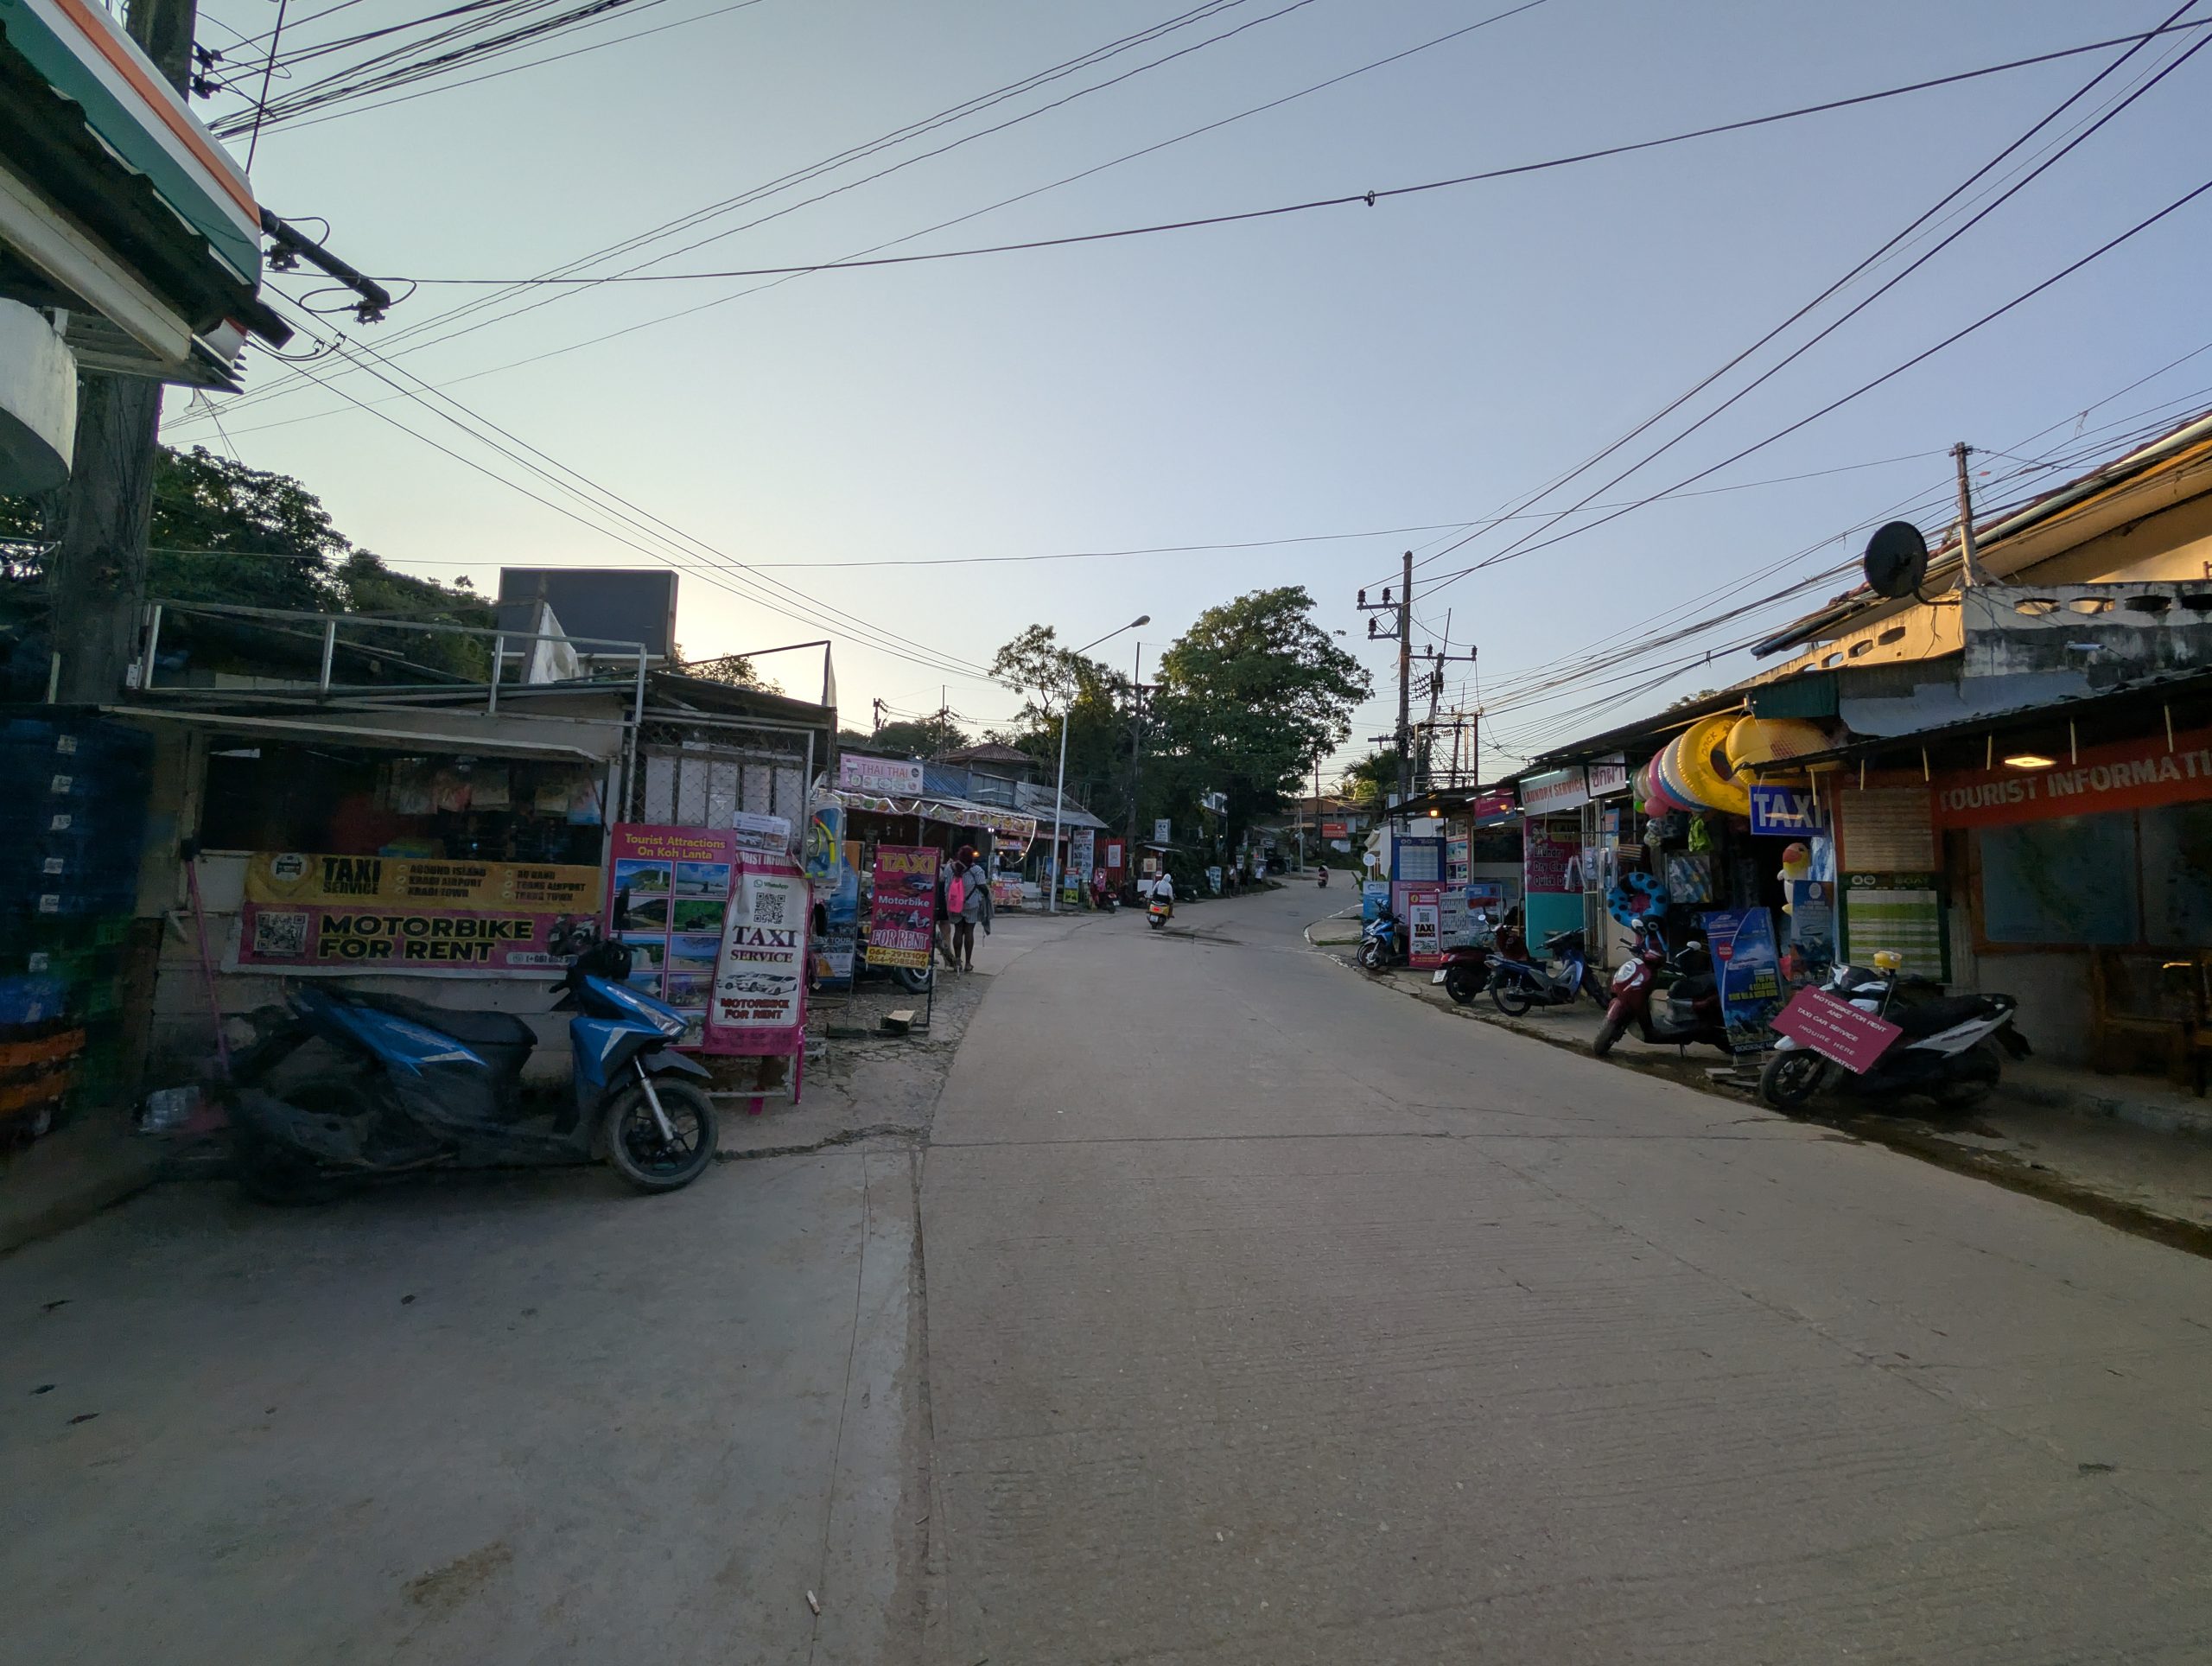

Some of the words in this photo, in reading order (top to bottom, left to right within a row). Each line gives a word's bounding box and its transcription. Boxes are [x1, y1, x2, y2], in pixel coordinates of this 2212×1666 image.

[861, 764, 883, 775] THAI
[887, 766, 908, 778] THAI
[1939, 777, 2037, 812] TOURIST
[2046, 748, 2212, 798] INFORMATI
[1522, 784, 1553, 804] LAUNDRY
[1554, 779, 1585, 798] SERVICE
[1753, 793, 1822, 829] TAXI
[626, 834, 664, 844] Tourist
[667, 836, 725, 849] Attractions
[638, 846, 654, 856] On
[658, 847, 679, 857] Koh
[683, 849, 712, 859] Lanta
[322, 858, 381, 882] TAXI
[879, 852, 936, 874] TAXI
[1534, 862, 1548, 873] Dry
[322, 881, 378, 894] SERVICE
[442, 878, 482, 887] AIRPORT
[1534, 874, 1555, 886] Quick
[879, 895, 930, 906] Motorbike
[322, 914, 532, 939] MOTORBIKE
[1414, 924, 1435, 932] TAXI
[733, 925, 797, 948] TAXI
[871, 929, 895, 948] FOR
[898, 930, 929, 950] RENT
[319, 938, 392, 959] FOR
[404, 940, 494, 961] RENT
[730, 950, 792, 963] SERVICE
[721, 998, 789, 1009] MOTORBIKE
[724, 1009, 750, 1019] FOR
[753, 1009, 783, 1020] RENT
[1813, 993, 1853, 1014] MOTORBIKE
[1852, 1012, 1867, 1025] FOR
[1867, 1020, 1887, 1033] RENT
[1827, 1009, 1843, 1020] AND
[1796, 1007, 1813, 1019] TAXI
[1812, 1015, 1827, 1026] CAR
[1828, 1024, 1859, 1042] SERVICE
[1798, 1024, 1831, 1043] INQUIRE
[1833, 1041, 1856, 1056] HERE
[1809, 1043, 1859, 1073] INFORMATION
